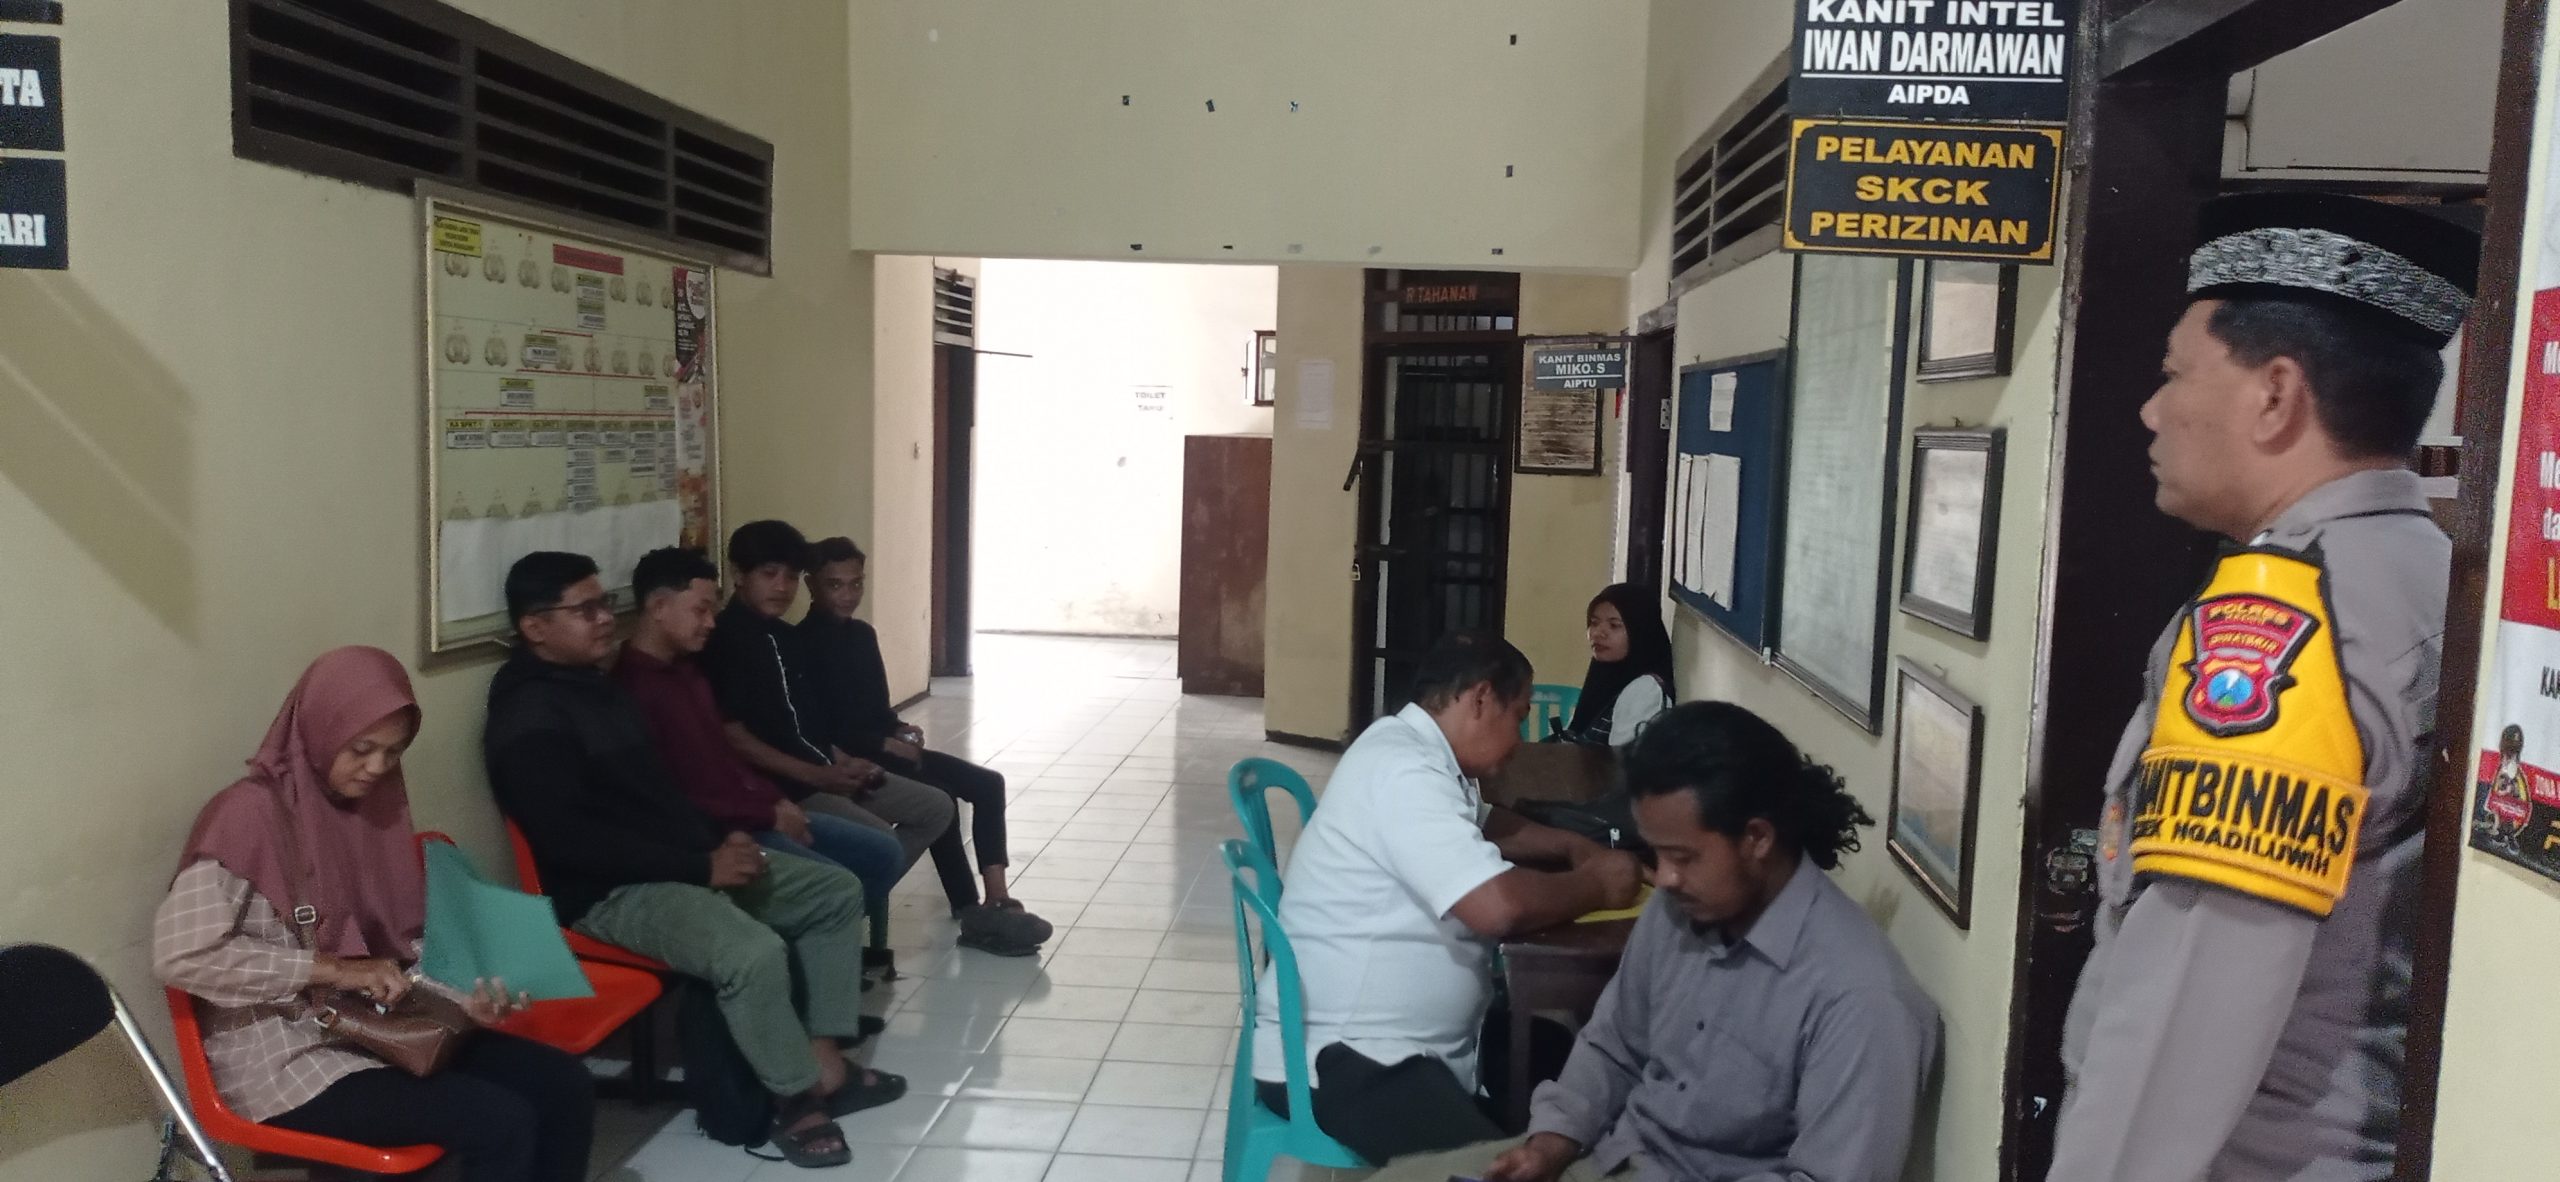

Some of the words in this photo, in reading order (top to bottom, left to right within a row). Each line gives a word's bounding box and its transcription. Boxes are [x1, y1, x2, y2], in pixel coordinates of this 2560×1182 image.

[1807, 0, 1934, 25] KANIT
[1946, 0, 2065, 27] INTEL
[1803, 29, 1881, 72] IWAN
[1889, 31, 2065, 75] DARMAWAN
[0, 68, 45, 107] TA
[1887, 84, 1970, 105] AIPDA
[1816, 136, 2035, 169] PELAYANAN
[1856, 175, 1990, 206] SKCK
[1810, 211, 2029, 245] PERIZINAN
[1538, 355, 1574, 364] KANIT
[1577, 353, 1621, 363] BINMAS
[1597, 363, 1606, 374] S
[1135, 391, 1166, 399] TOILET
[1563, 379, 1597, 389] AIPTU
